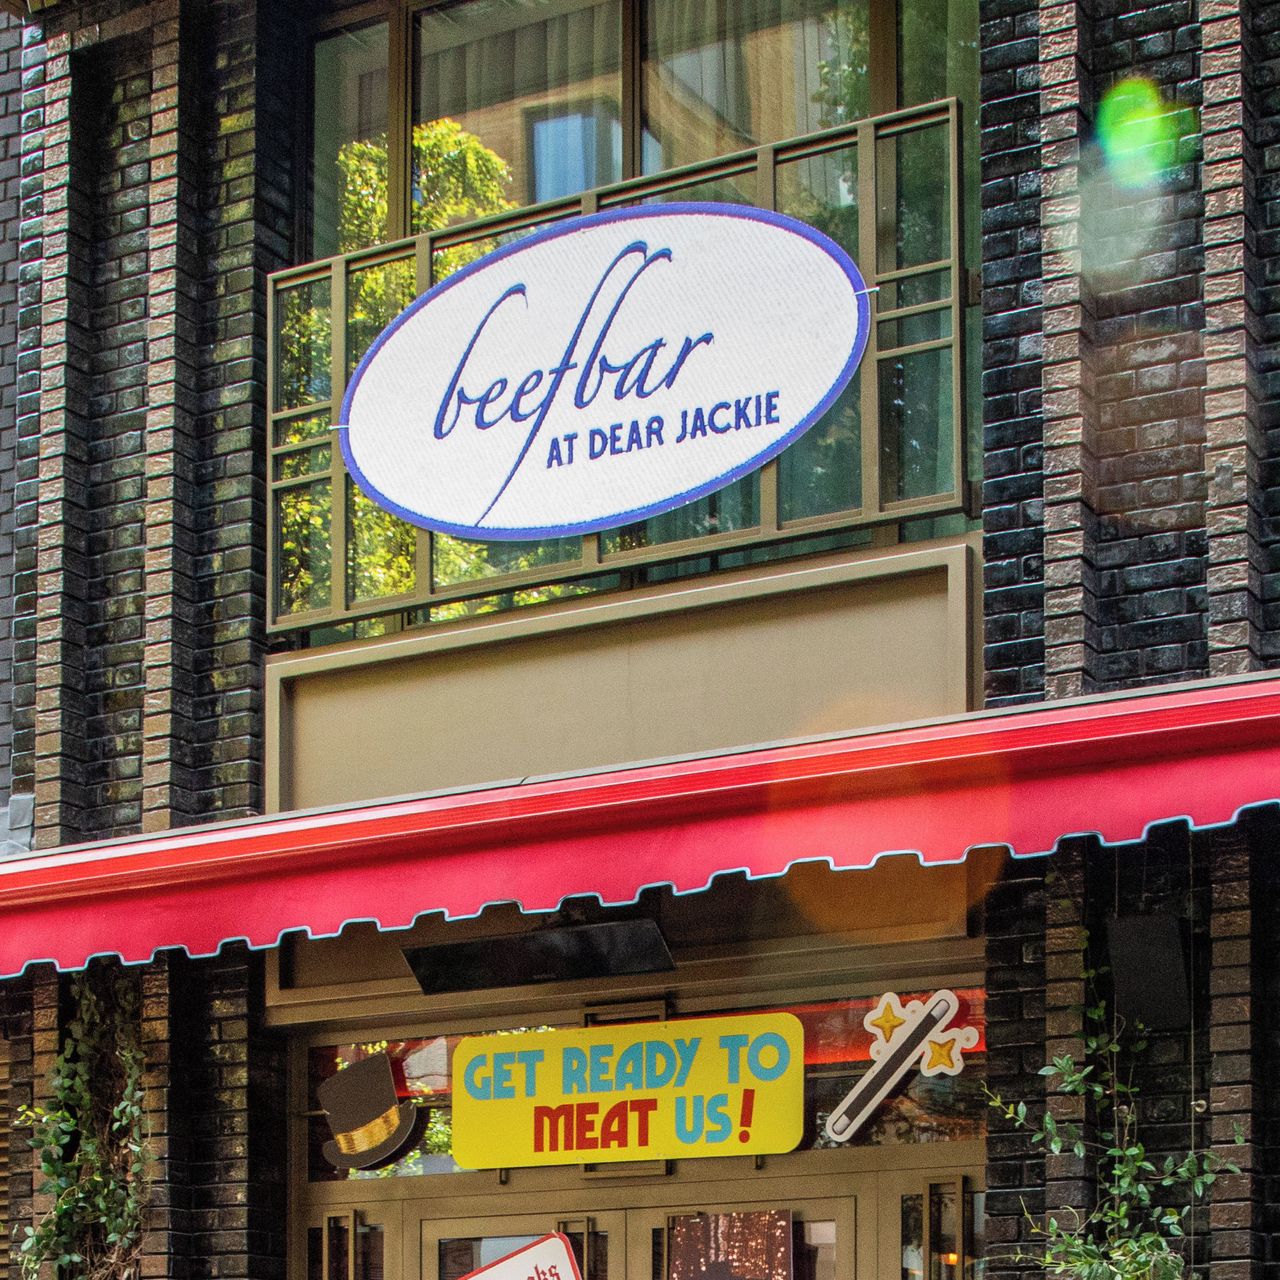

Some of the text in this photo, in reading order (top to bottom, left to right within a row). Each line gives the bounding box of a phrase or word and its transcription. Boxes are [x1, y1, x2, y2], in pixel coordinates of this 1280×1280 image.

[433, 240, 715, 527] beefbar
[547, 391, 780, 469] AT DEAR JACKIE
[463, 1031, 791, 1100] GET READY TO
[533, 1088, 755, 1152] MEAT US!
